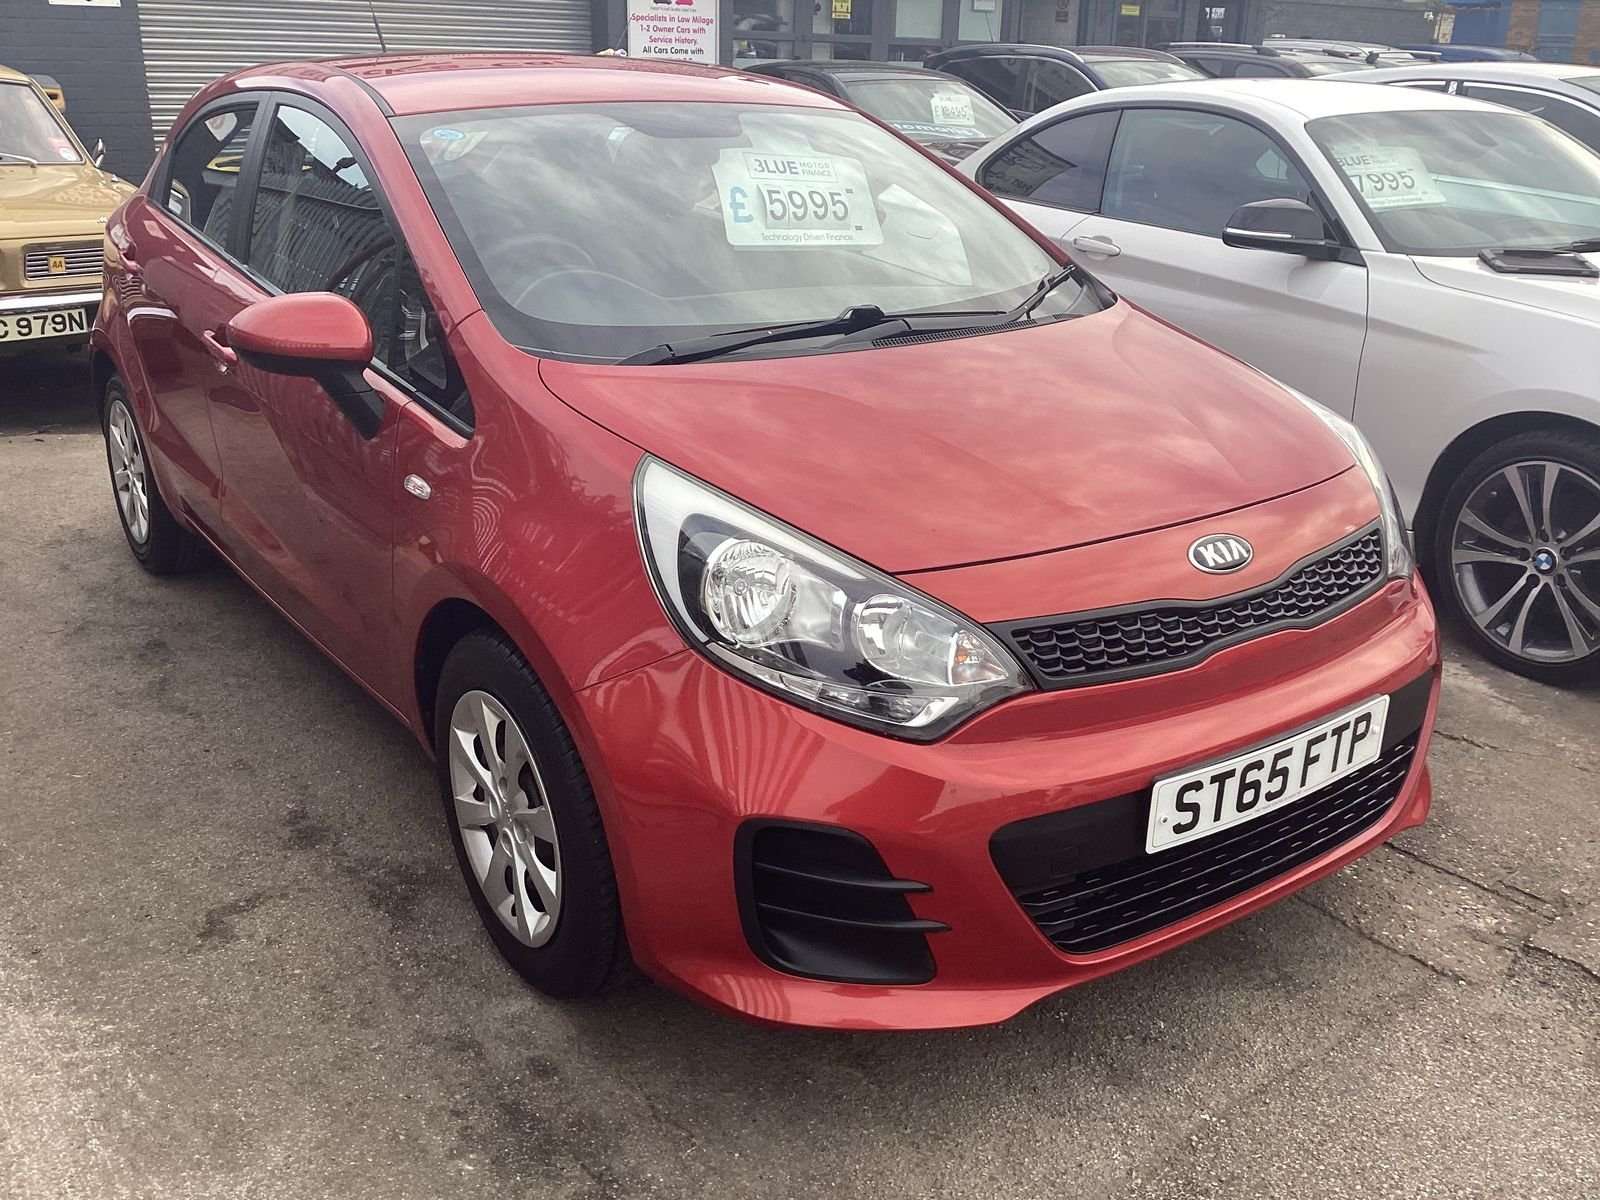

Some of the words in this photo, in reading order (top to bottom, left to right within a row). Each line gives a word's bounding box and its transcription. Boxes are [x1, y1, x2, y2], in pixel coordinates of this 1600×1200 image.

[631, 13, 667, 22] Specialists
[669, 14, 675, 22] in
[678, 15, 690, 23] Low
[692, 15, 714, 26] Milage
[640, 24, 651, 32] 1-2
[652, 25, 674, 33] Owner
[676, 26, 691, 34] Cars
[648, 35, 673, 44] Service
[642, 46, 652, 54] All
[653, 46, 669, 54] Cars
[670, 47, 689, 55] Come
[690, 47, 704, 55] with
[15, 311, 85, 337] 979N
[1197, 538, 1250, 567] KIA
[1172, 746, 1294, 835] ST65
[1300, 711, 1373, 789] FTP
